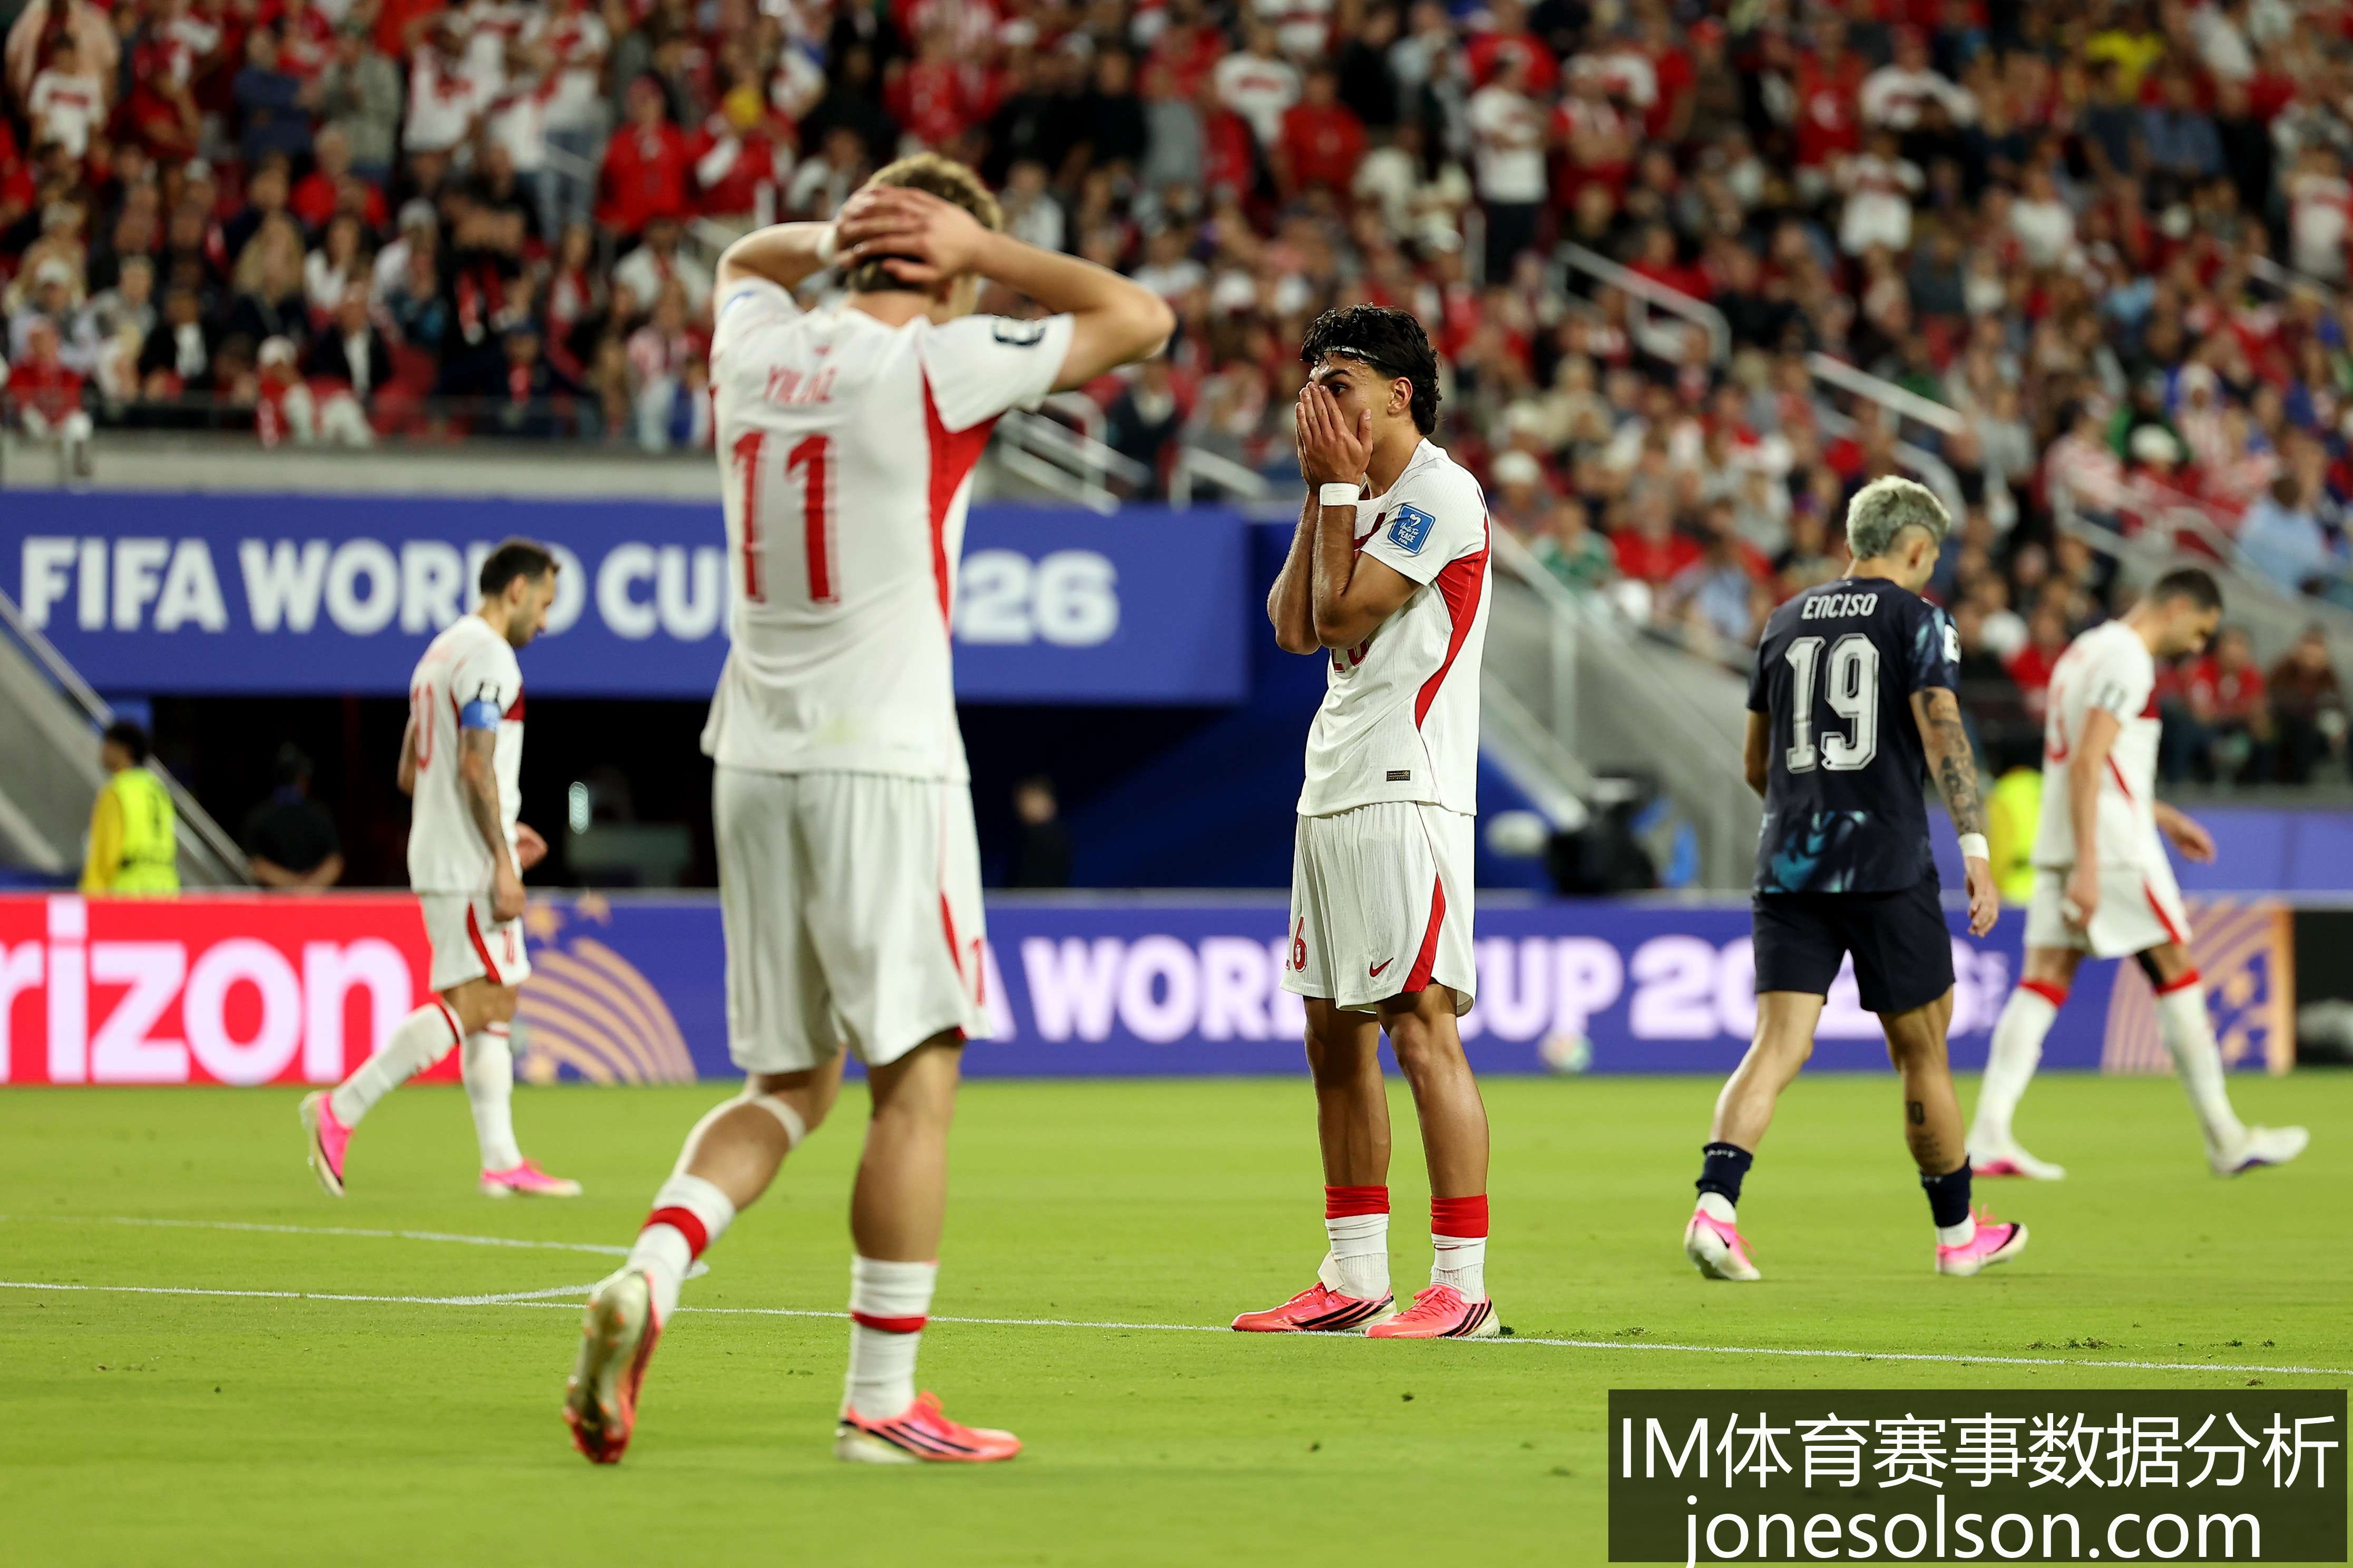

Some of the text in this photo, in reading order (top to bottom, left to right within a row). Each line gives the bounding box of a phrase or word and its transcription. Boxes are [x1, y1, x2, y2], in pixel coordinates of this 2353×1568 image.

[733, 429, 840, 605] 11
[1398, 528, 1416, 543] PEACE
[20, 535, 228, 633] FIFA
[597, 540, 727, 643] CU
[1801, 592, 1879, 620] ENCISO
[1784, 632, 1880, 775] 19
[1020, 934, 1307, 1043] WORL
[1457, 935, 1624, 1043] UP
[1285, 916, 1307, 973] 6
